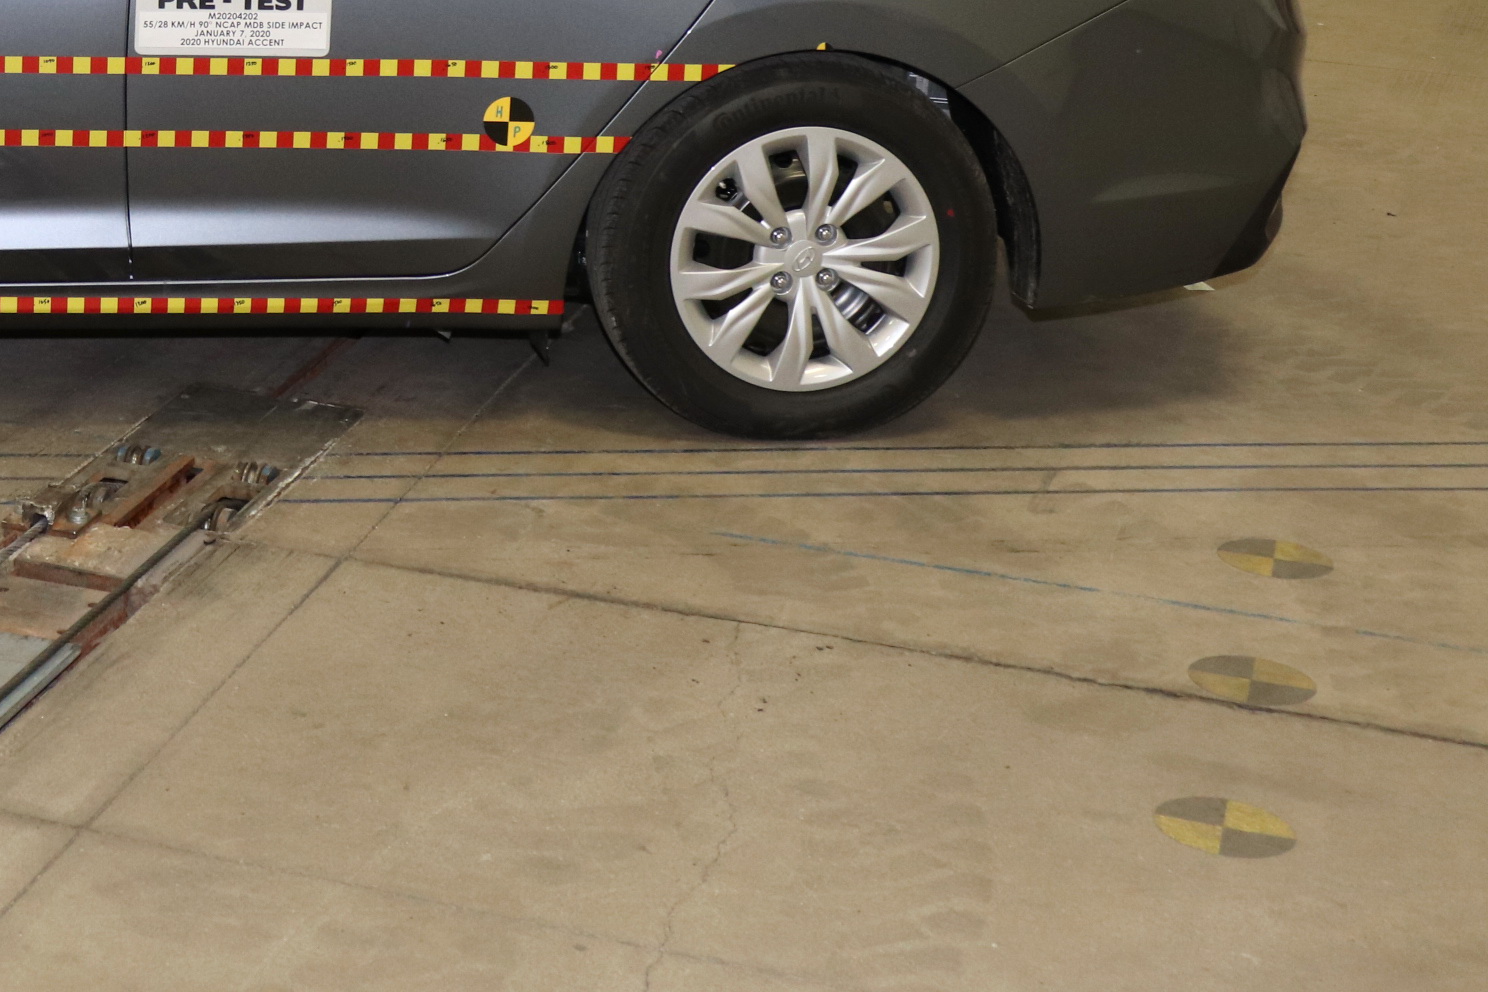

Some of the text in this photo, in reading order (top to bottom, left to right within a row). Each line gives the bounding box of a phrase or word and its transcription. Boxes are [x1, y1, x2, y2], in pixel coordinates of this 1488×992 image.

[208, 12, 258, 20] M20204202
[215, 21, 241, 29] NCAP
[244, 21, 264, 29] MDB
[288, 22, 323, 30] IMPACT
[250, 30, 271, 38] 2020
[180, 38, 201, 46] 2020
[247, 39, 284, 47] ACCENT
[496, 105, 504, 119] H
[513, 125, 521, 138] P
